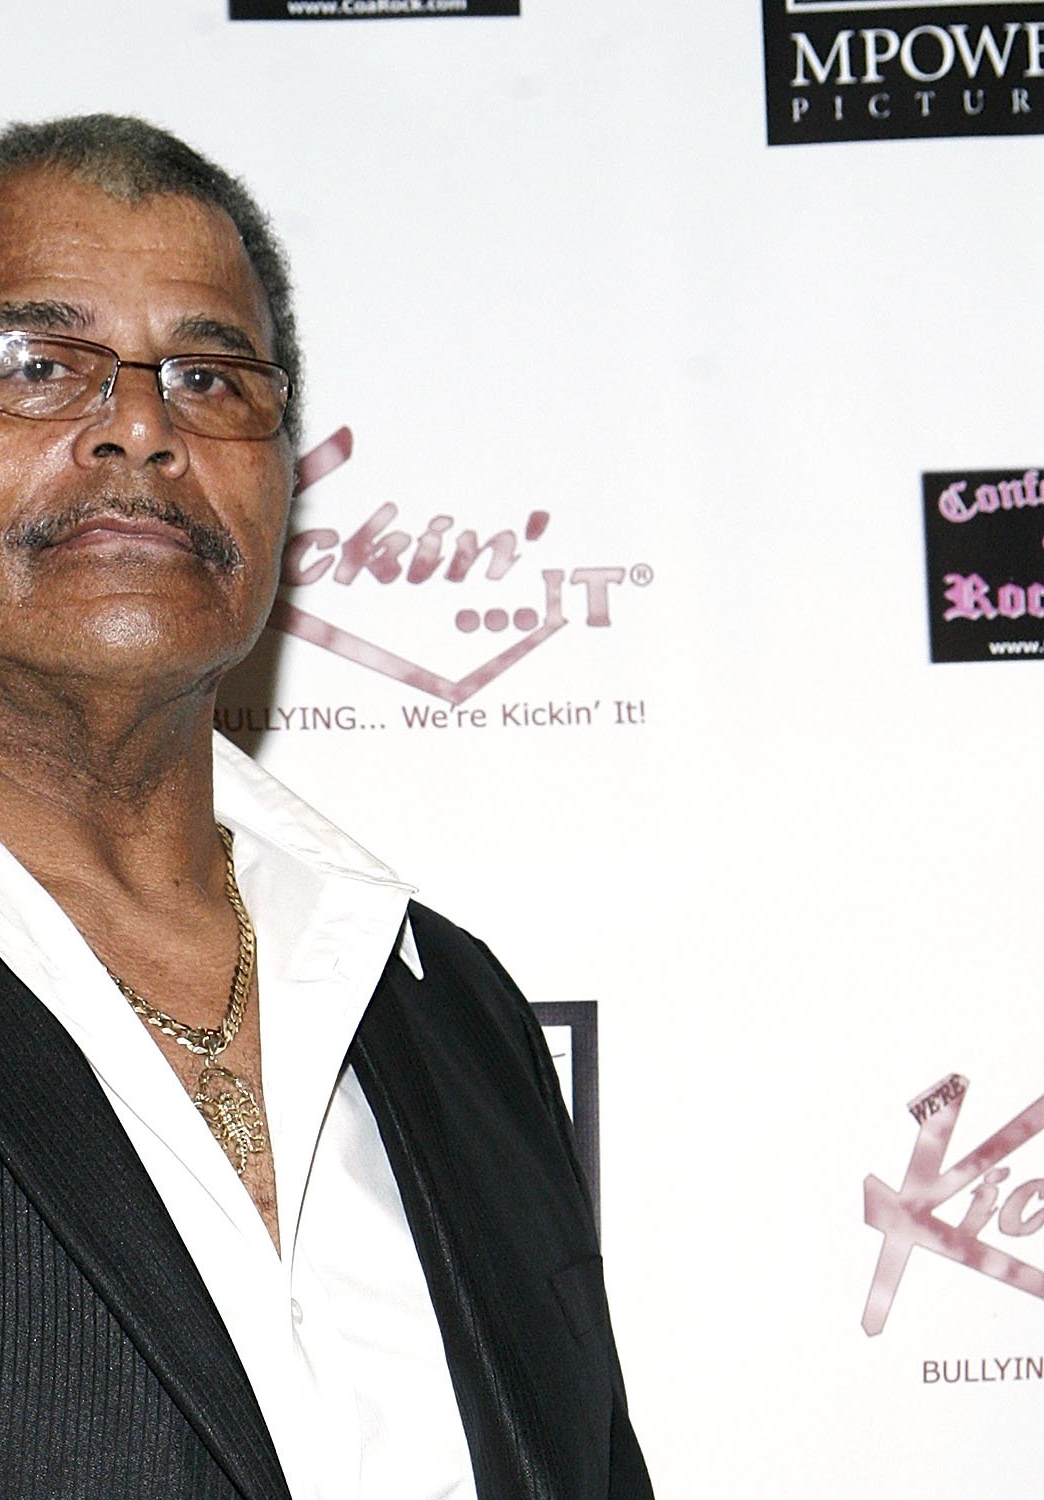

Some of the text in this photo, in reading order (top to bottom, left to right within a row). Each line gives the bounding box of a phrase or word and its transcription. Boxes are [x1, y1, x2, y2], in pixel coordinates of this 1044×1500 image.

[938, 469, 1044, 523] Conf
[402, 702, 487, 728] We're
[502, 700, 600, 727] Kickin'
[614, 699, 647, 724] It!
